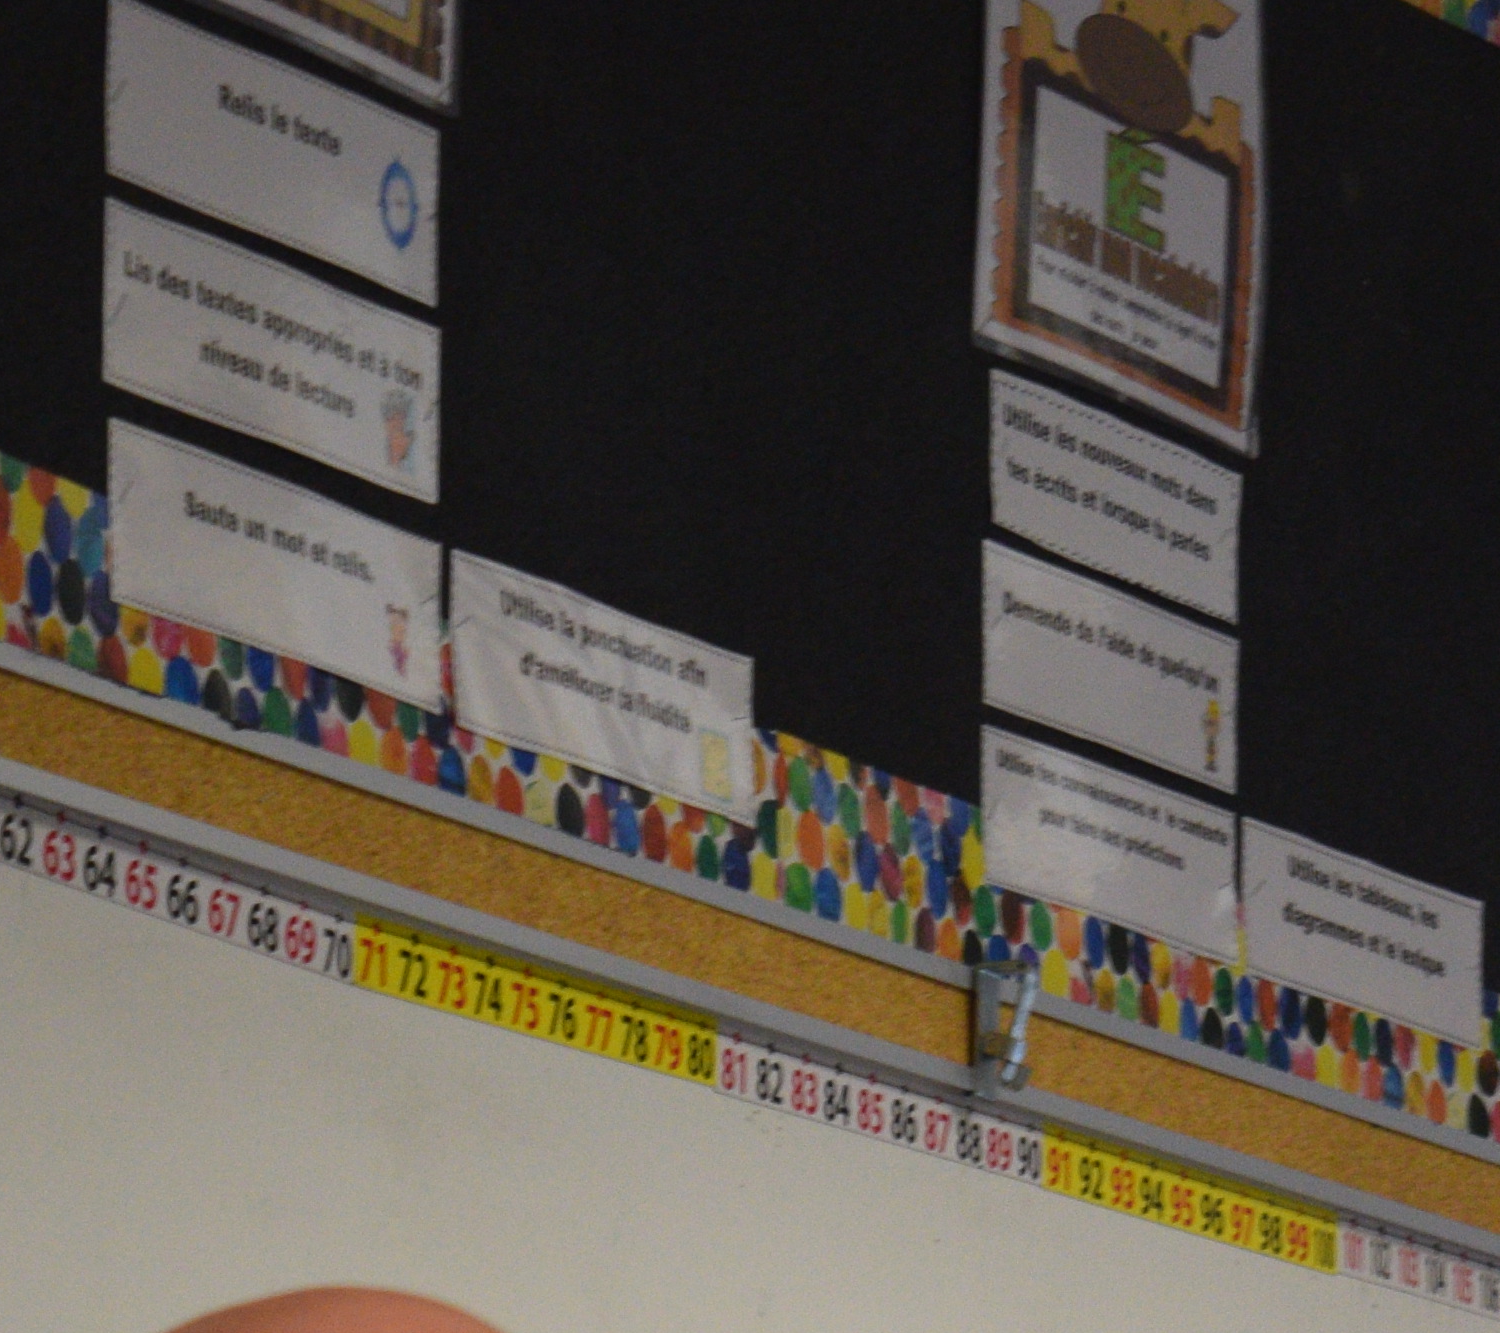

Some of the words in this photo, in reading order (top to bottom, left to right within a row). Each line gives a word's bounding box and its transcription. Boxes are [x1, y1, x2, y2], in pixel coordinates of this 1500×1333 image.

[219, 83, 265, 125] Relis
[271, 104, 289, 135] le
[293, 116, 341, 157] texte
[123, 250, 152, 284] Lis
[157, 266, 192, 299] des
[183, 491, 240, 532] Saute
[244, 518, 267, 543] un
[272, 527, 306, 556] mot
[0, 814, 32, 867] 62
[43, 830, 76, 881] 63
[84, 845, 116, 898] 64
[125, 860, 157, 910] 65
[166, 875, 199, 924] 66
[208, 889, 240, 937] 67
[248, 903, 278, 952] 68
[285, 915, 316, 964] 69
[324, 928, 351, 978] 70
[361, 937, 387, 987] 71
[399, 949, 428, 998] 72
[439, 961, 466, 1009] 73
[474, 972, 501, 1020] 74
[512, 982, 540, 1029] 75
[549, 992, 576, 1040] 76
[585, 1004, 612, 1051] 77
[620, 1014, 649, 1062] 78
[654, 1023, 680, 1070] 79
[688, 1033, 715, 1080] 80
[722, 1048, 746, 1094] 81
[757, 1058, 783, 1105] 82
[791, 1069, 817, 1115] 83
[825, 1080, 850, 1125] 84
[858, 1088, 884, 1134] 85
[891, 1099, 917, 1144] 86
[924, 1109, 950, 1153] 87
[956, 1118, 981, 1163] 88
[986, 1128, 1012, 1172] 89
[1019, 1137, 1042, 1180] 90
[1048, 1146, 1071, 1190] 91
[1080, 1156, 1102, 1199] 92
[1111, 1166, 1134, 1209] 93
[1140, 1176, 1163, 1219] 94
[1171, 1184, 1194, 1226] 95
[1201, 1193, 1224, 1236] 96
[1231, 1203, 1254, 1245] 97
[1260, 1212, 1281, 1254] 98
[1288, 1220, 1310, 1262] 99
